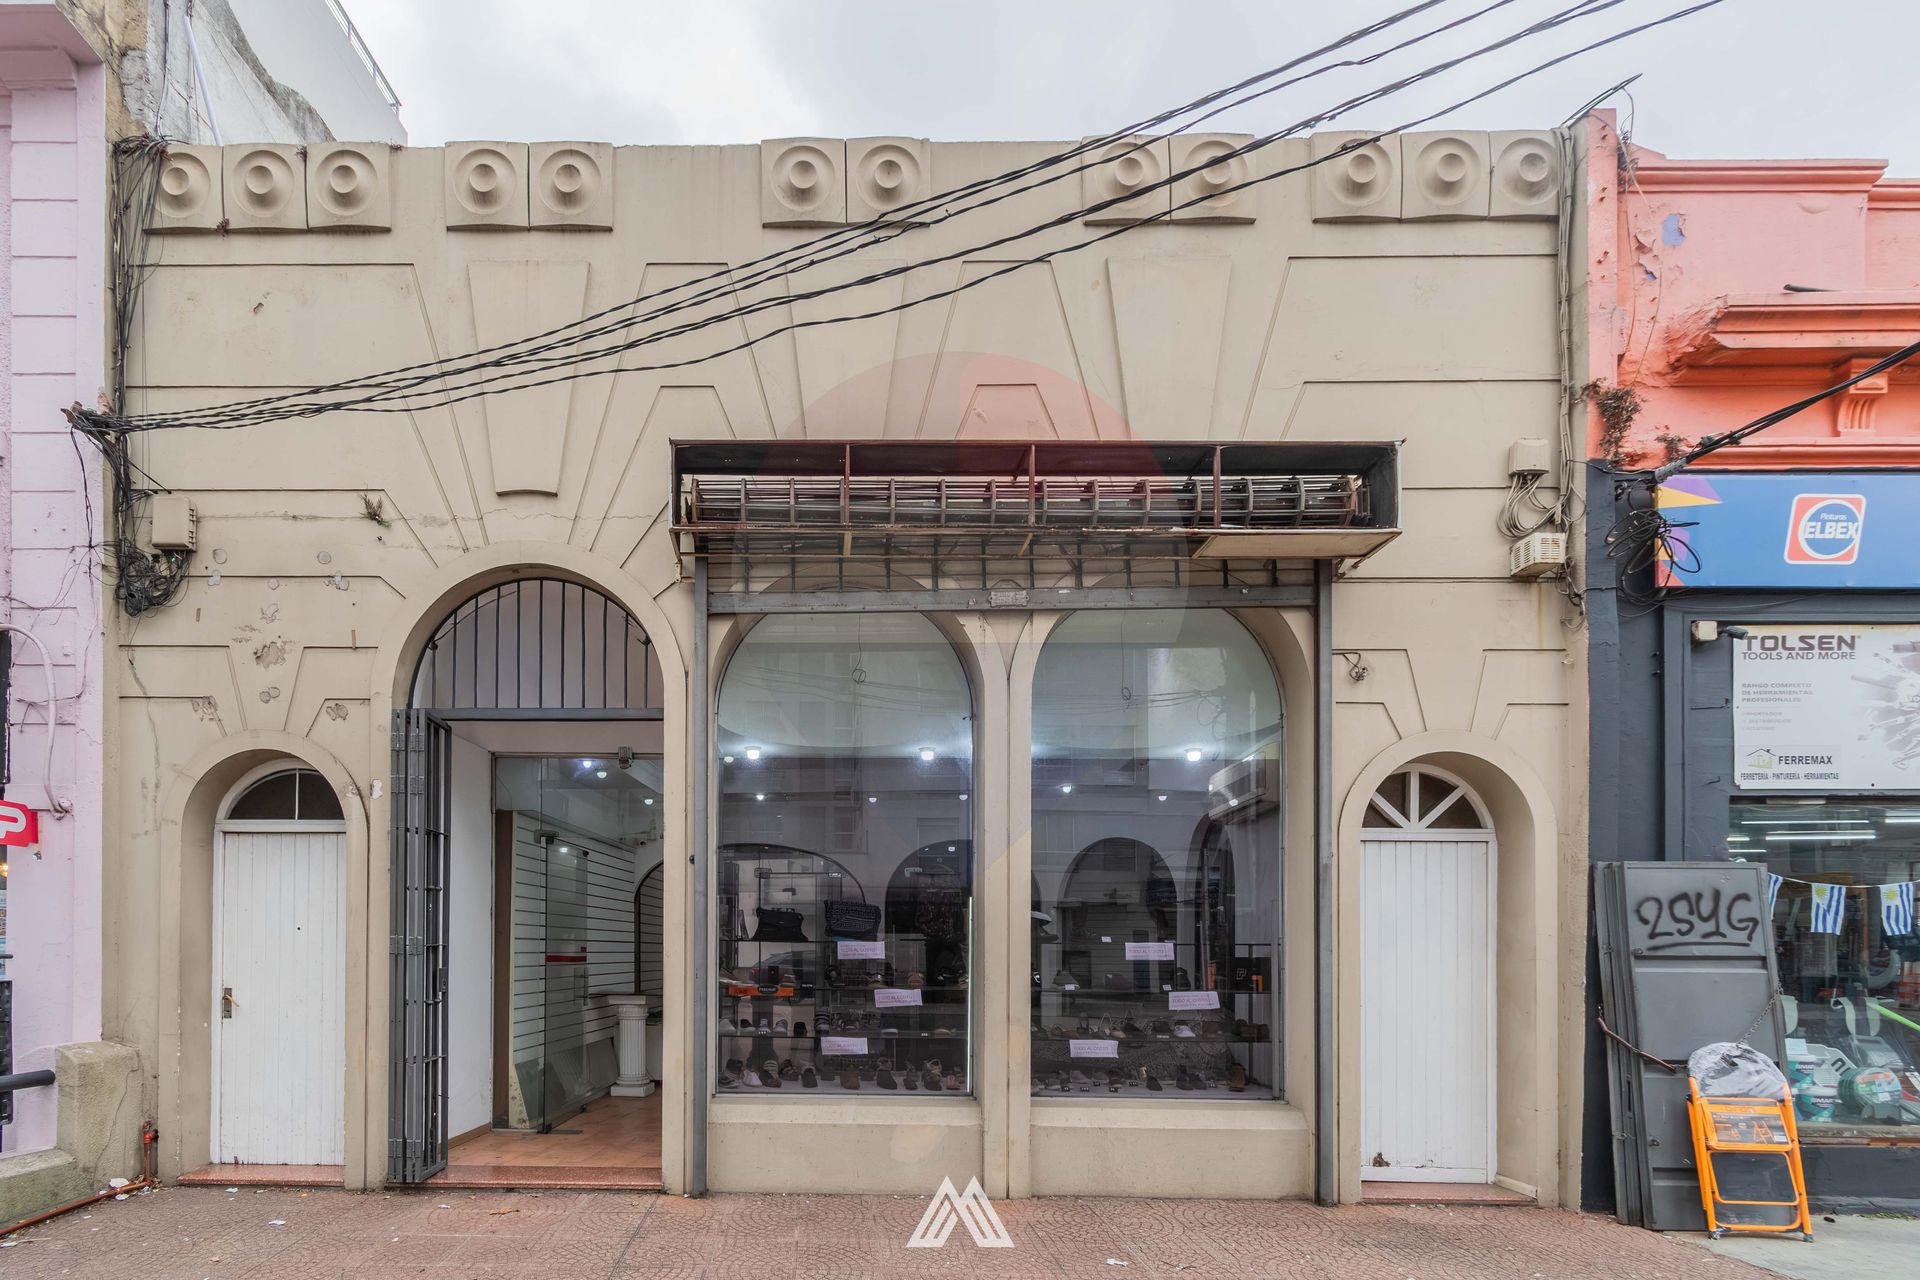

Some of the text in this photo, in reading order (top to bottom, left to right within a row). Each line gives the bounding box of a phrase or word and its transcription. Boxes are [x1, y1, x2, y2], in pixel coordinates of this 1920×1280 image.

[1820, 512, 1848, 520] Pinturas
[1804, 521, 1858, 539] ELBEX
[1743, 635, 1856, 652] TOLSEN
[1741, 652, 1856, 661] TOOLS AND MORE
[1778, 755, 1833, 765] FERREMAX
